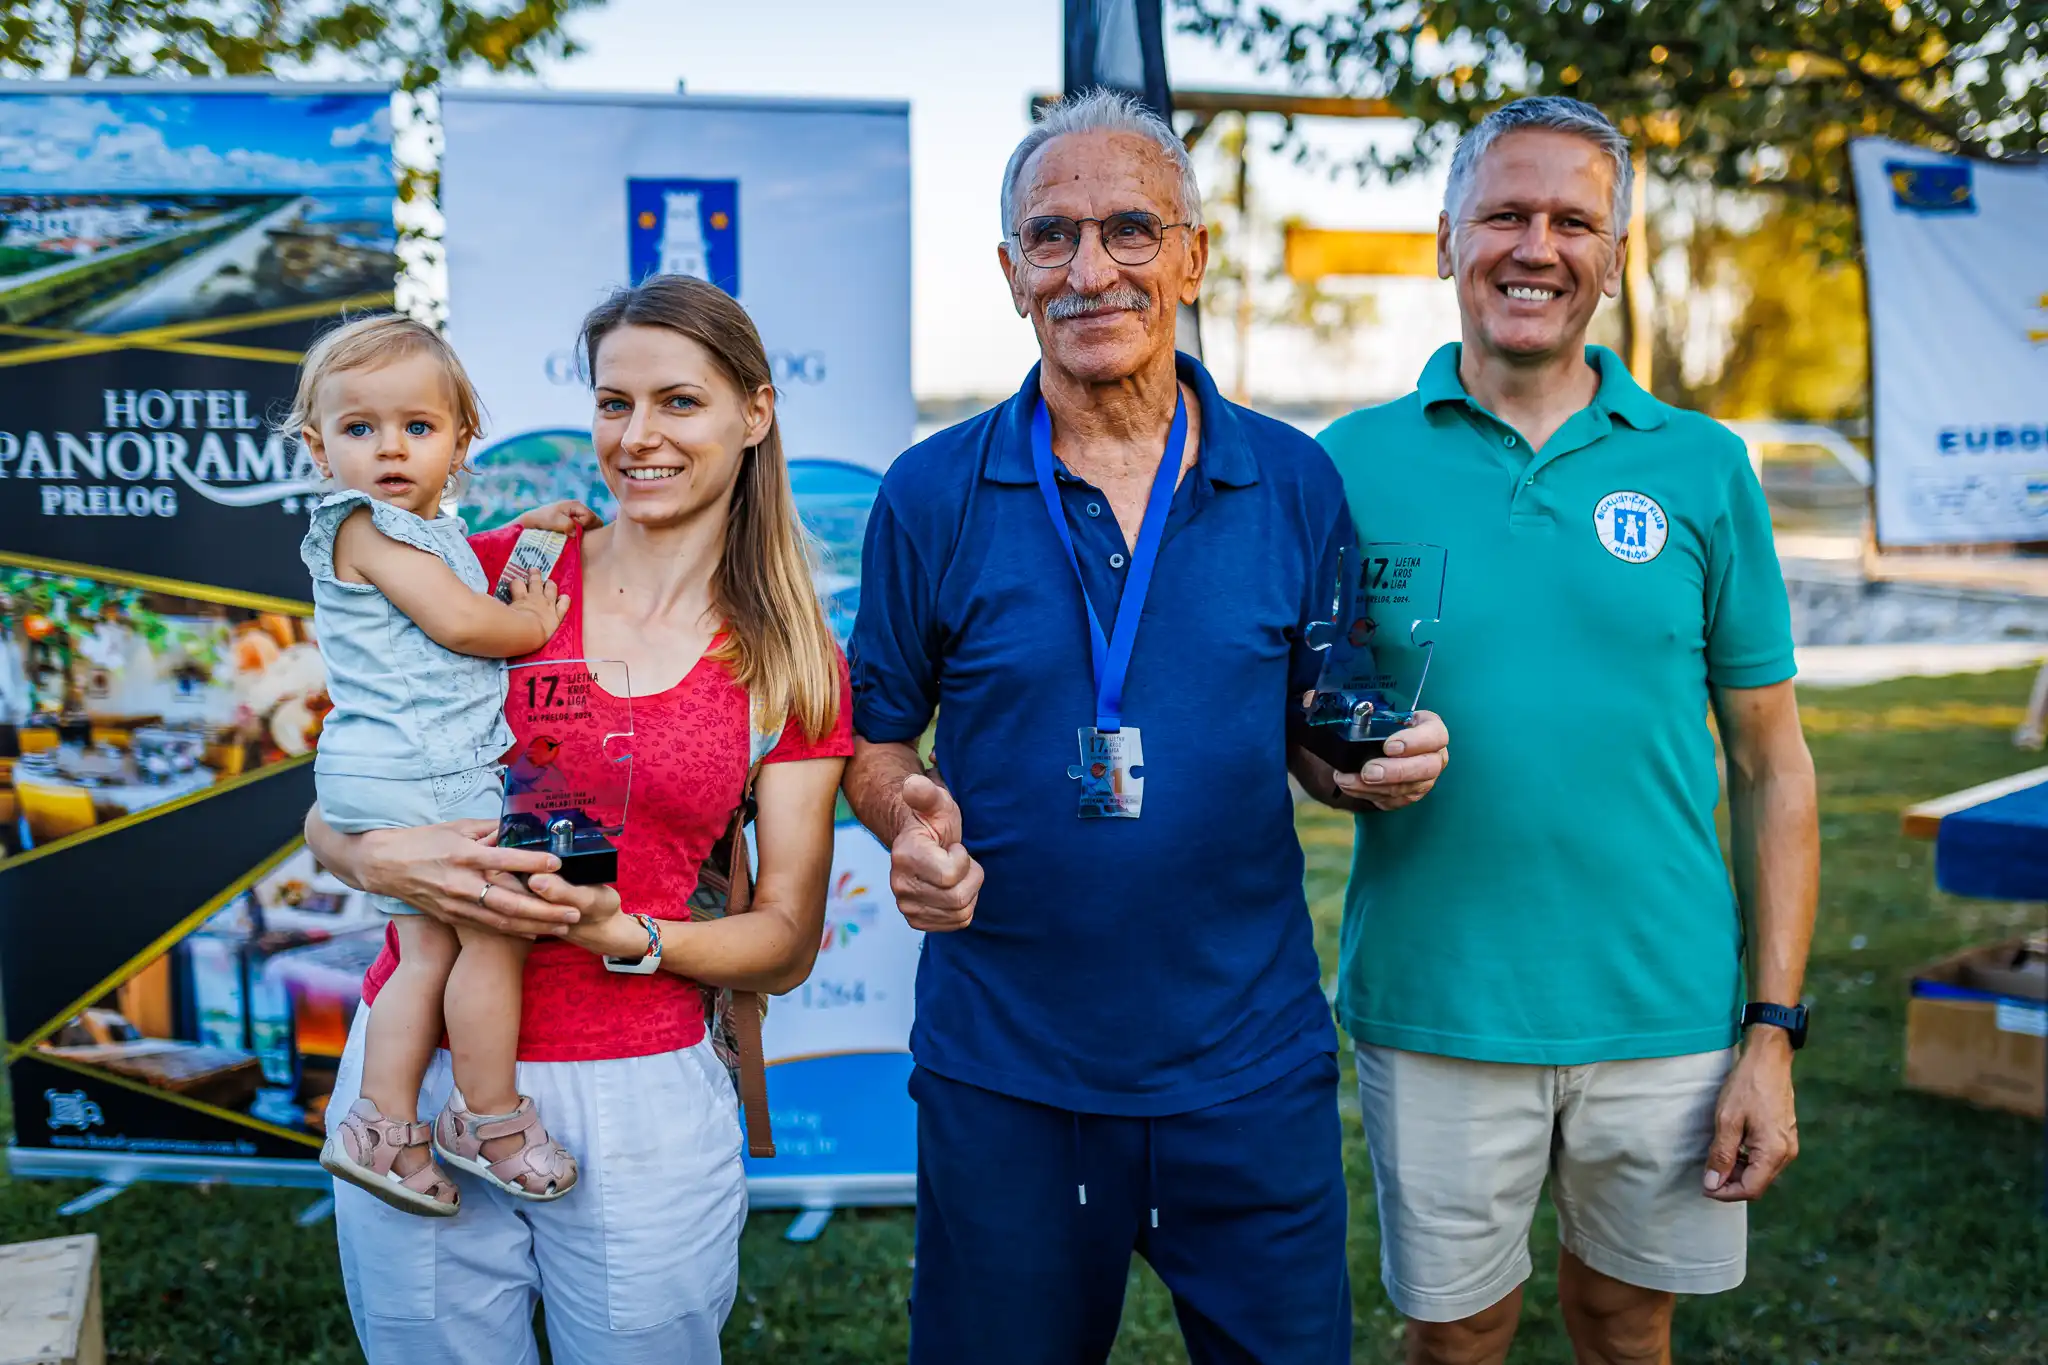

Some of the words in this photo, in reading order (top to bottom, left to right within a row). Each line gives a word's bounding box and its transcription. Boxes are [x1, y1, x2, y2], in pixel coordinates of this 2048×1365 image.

[102, 388, 260, 429] HOTEL
[1938, 424, 2048, 455] EURO
[40, 485, 178, 517] PRELOG
[1359, 557, 1389, 589] 17.
[1390, 579, 1407, 589] LIGA
[1392, 569, 1412, 578] KROS
[525, 675, 564, 708] 17.
[567, 695, 587, 706] LIGA
